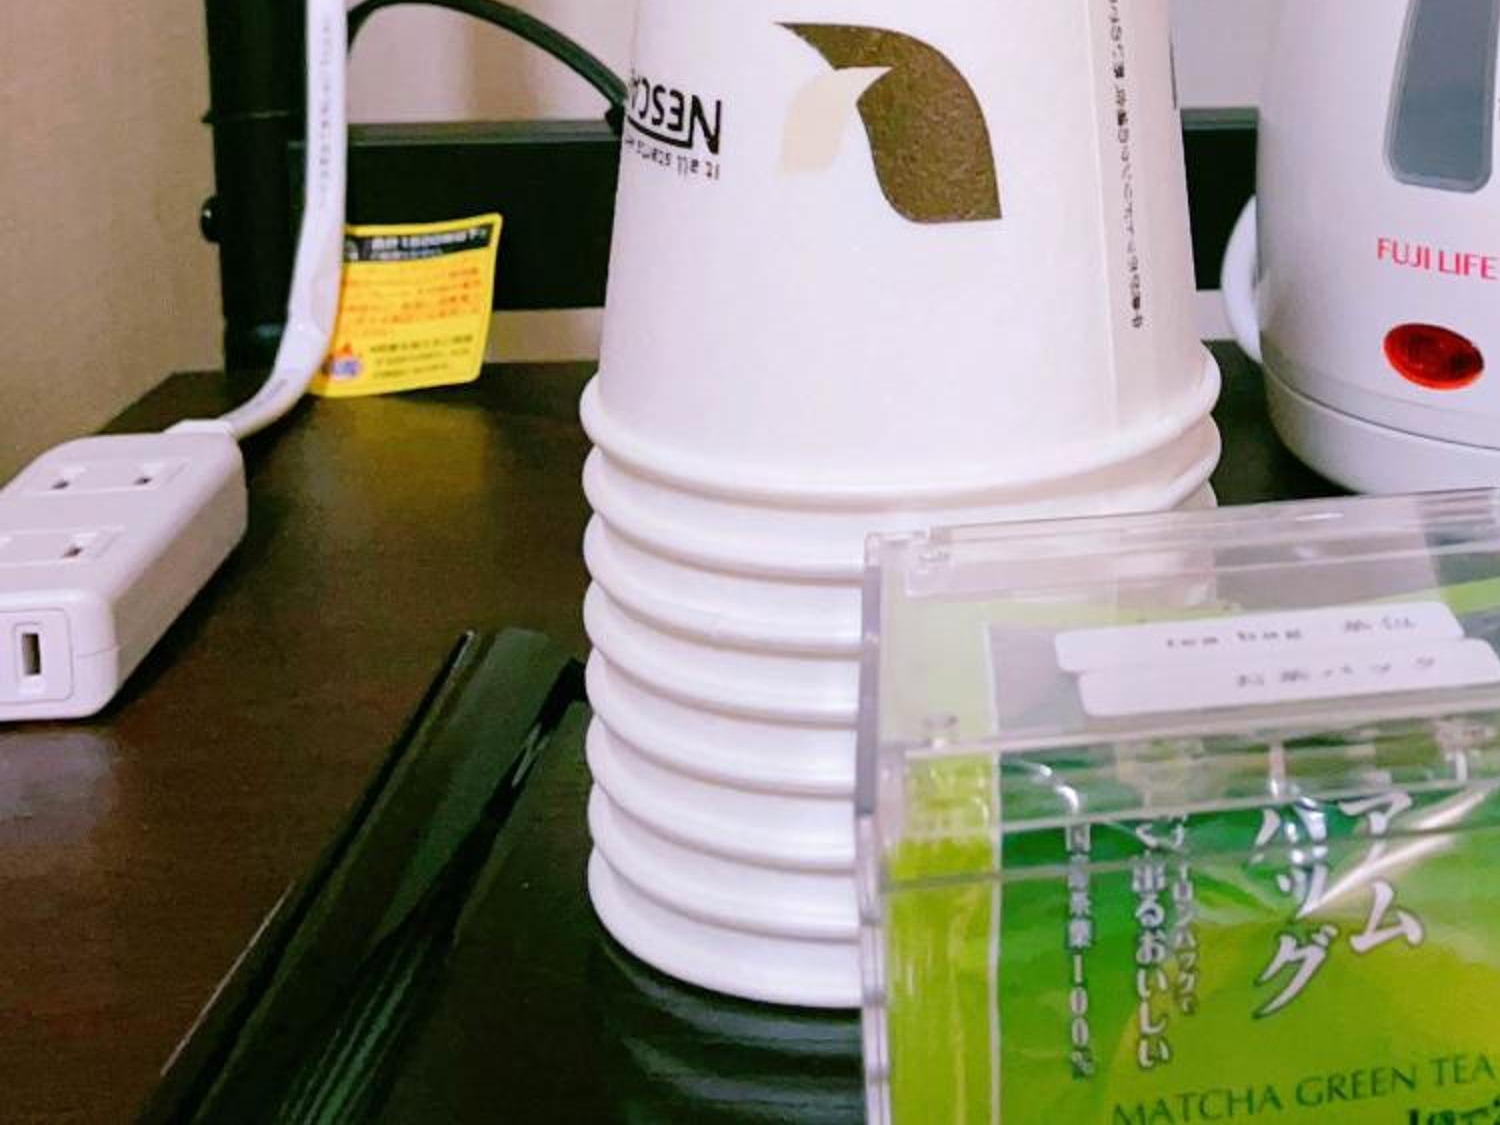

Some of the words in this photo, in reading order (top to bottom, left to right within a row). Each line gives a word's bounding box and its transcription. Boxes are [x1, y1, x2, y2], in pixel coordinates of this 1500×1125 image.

[1377, 236, 1430, 270] FUJI
[1438, 248, 1500, 281] LIFE
[1111, 1083, 1284, 1125] MATCHA
[1294, 1063, 1419, 1109] GREEN
[1430, 1053, 1500, 1088] TEA
